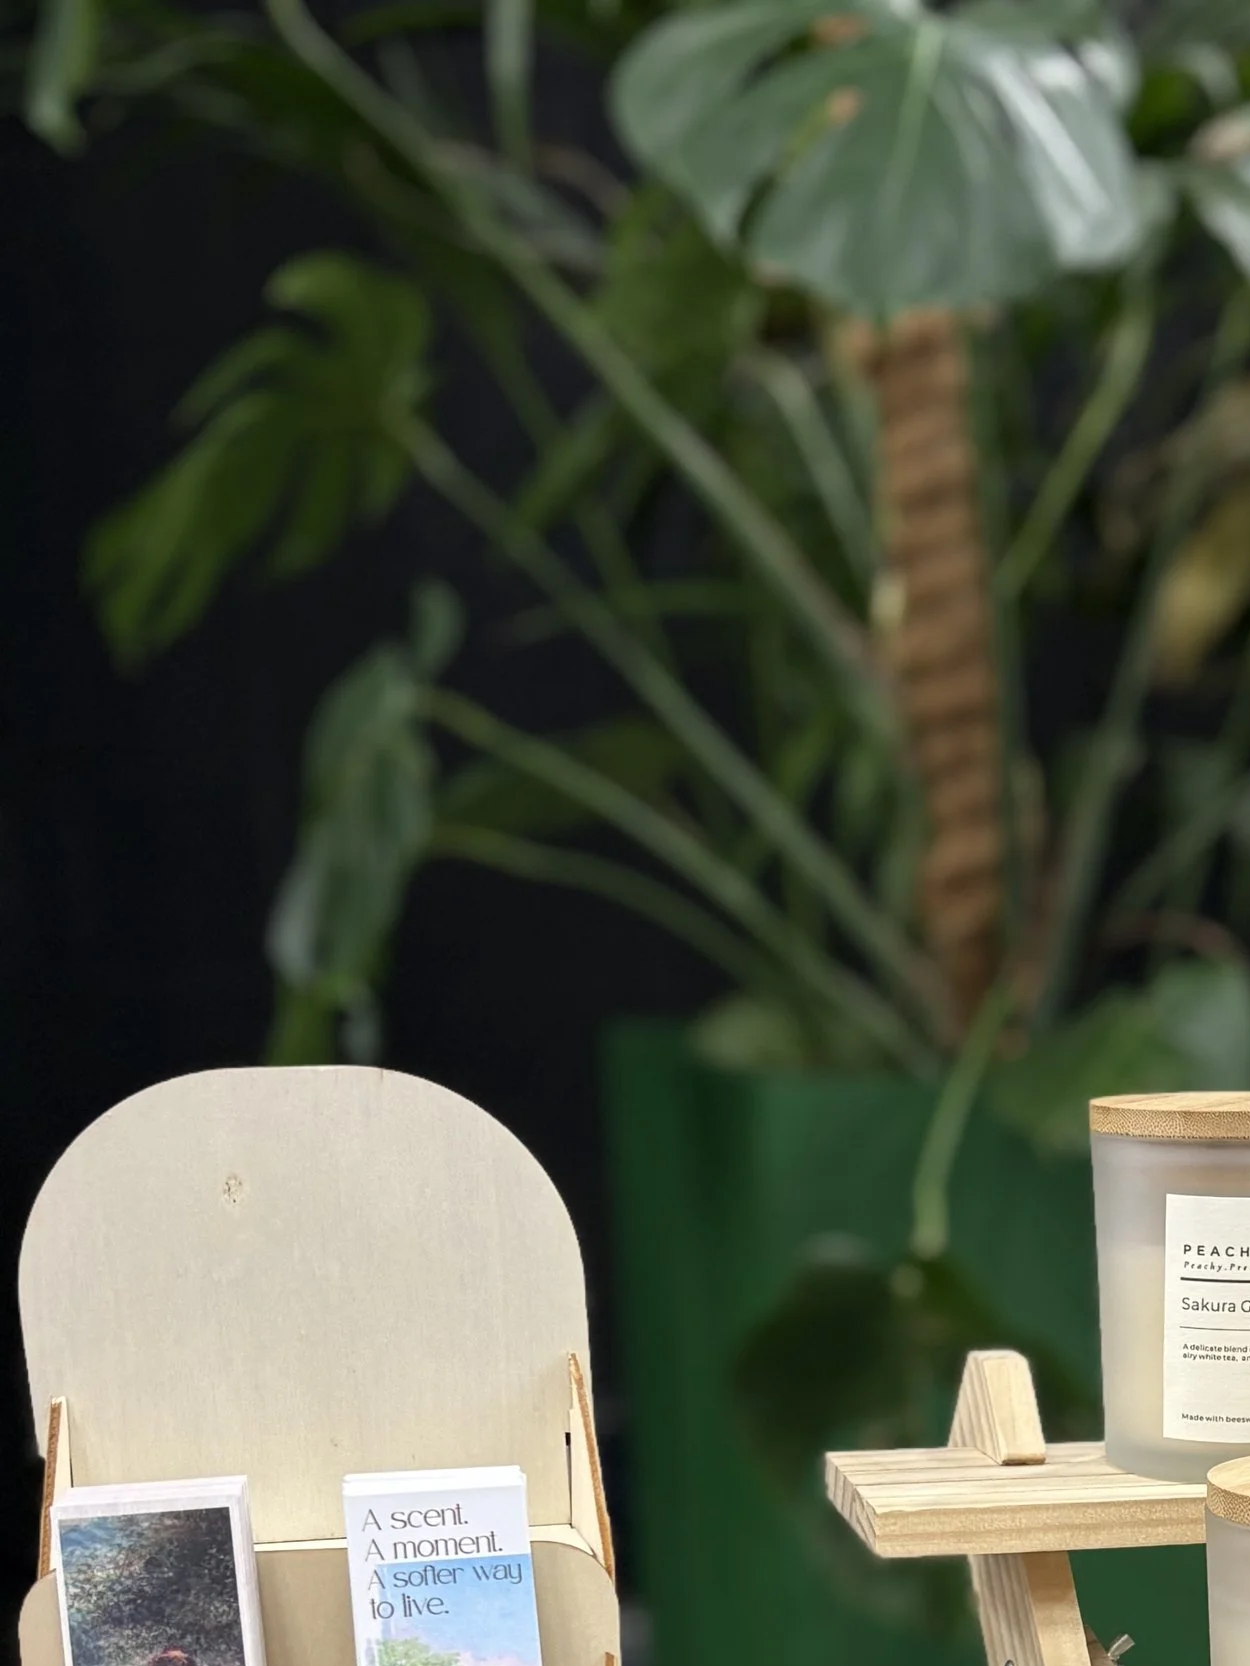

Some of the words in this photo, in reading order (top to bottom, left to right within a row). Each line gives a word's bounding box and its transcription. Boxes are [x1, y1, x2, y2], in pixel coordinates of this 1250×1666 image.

[1183, 1245, 1250, 1257] PEACH
[1181, 1298, 1236, 1312] Sakura
[1190, 1344, 1222, 1352] delicate
[362, 1509, 382, 1532] A
[391, 1503, 468, 1530] scent.
[365, 1538, 385, 1561] A
[393, 1531, 503, 1560] moment.
[368, 1569, 385, 1590] A
[393, 1565, 464, 1588] softer
[473, 1563, 522, 1585] way
[369, 1598, 394, 1620] to
[402, 1593, 449, 1618] live.
